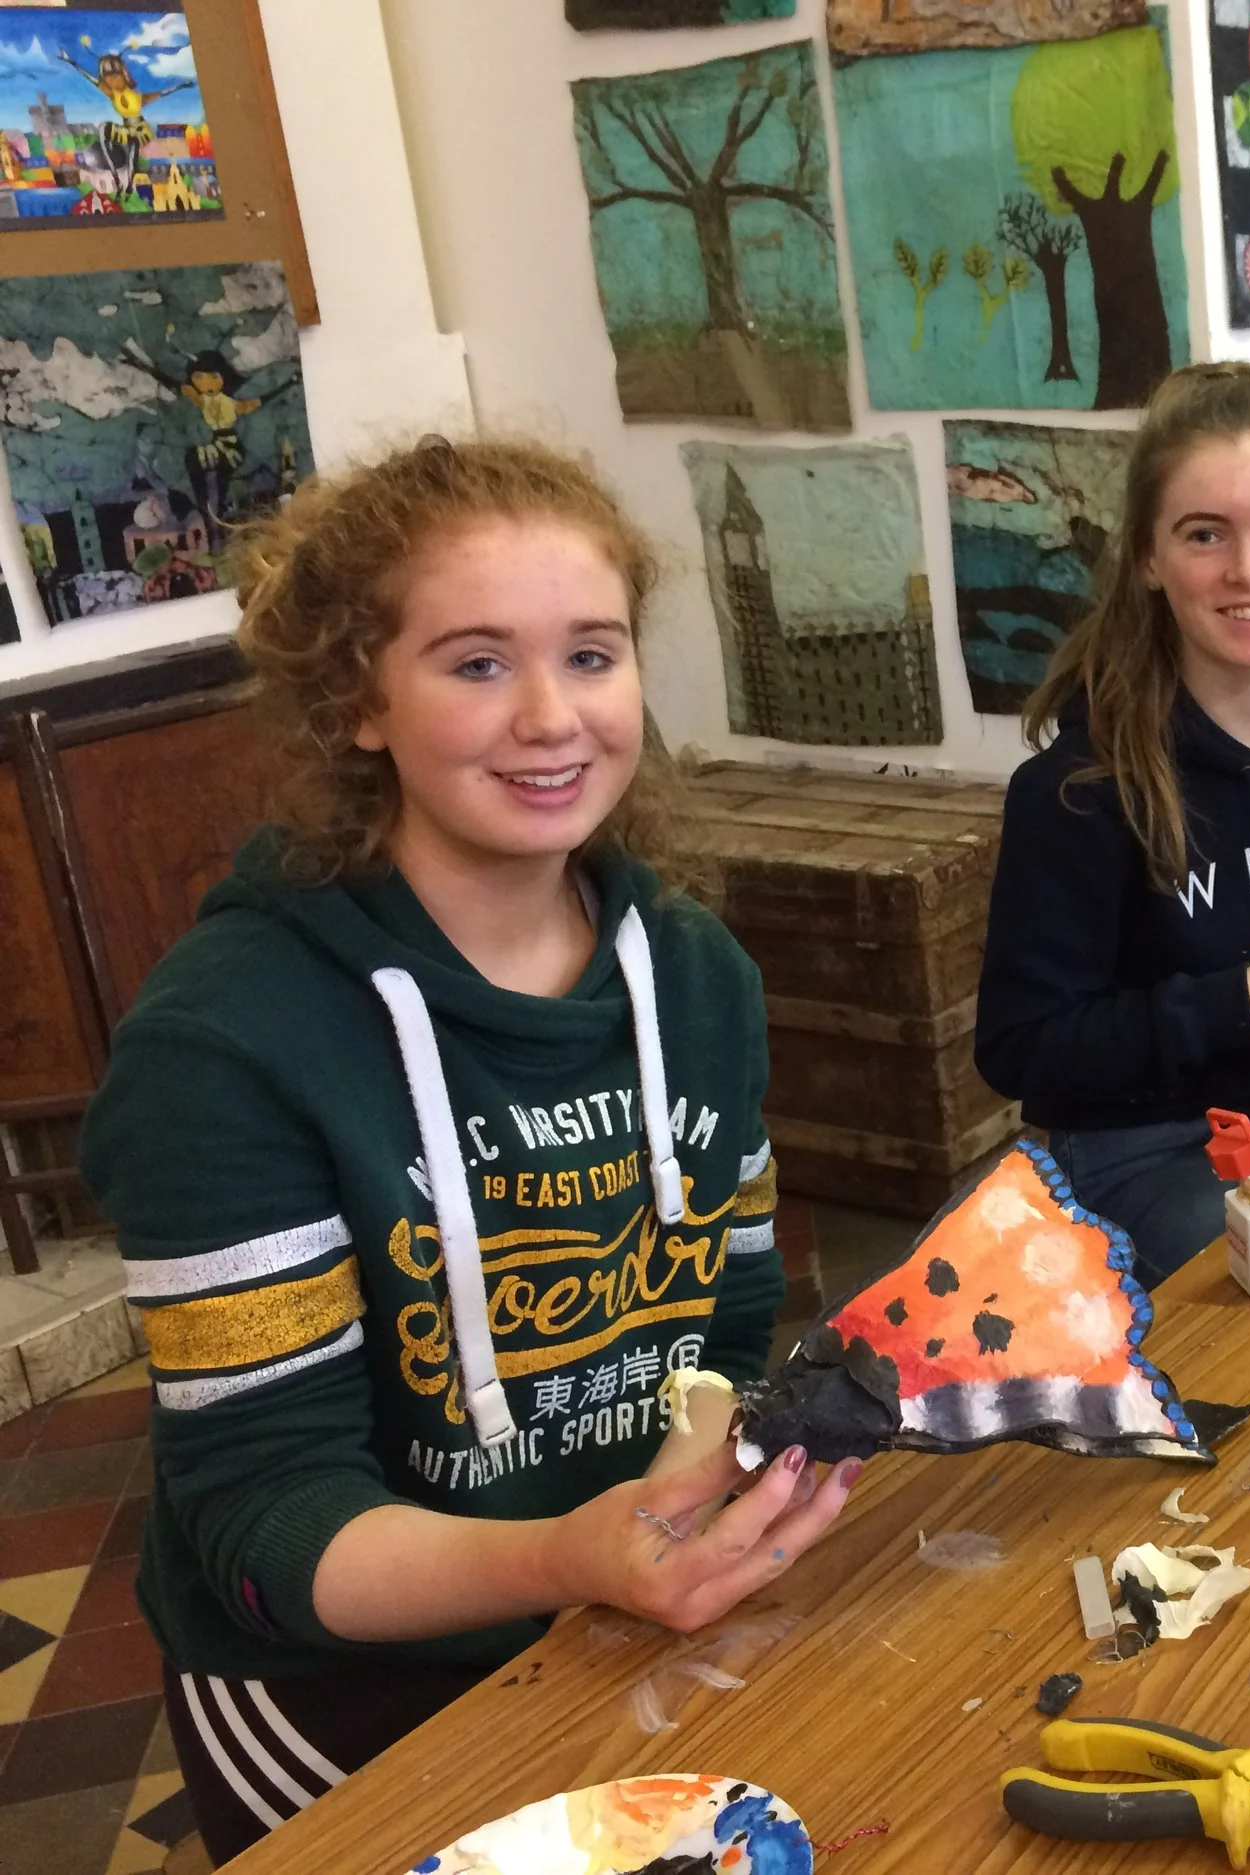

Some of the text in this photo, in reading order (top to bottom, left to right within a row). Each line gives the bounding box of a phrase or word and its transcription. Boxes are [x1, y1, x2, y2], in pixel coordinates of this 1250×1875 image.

[483, 1151, 640, 1208] 19 EAST COAST
[529, 1344, 662, 1420] 東海岸
[408, 1394, 673, 1490] AUTHENTIC SPORTS
